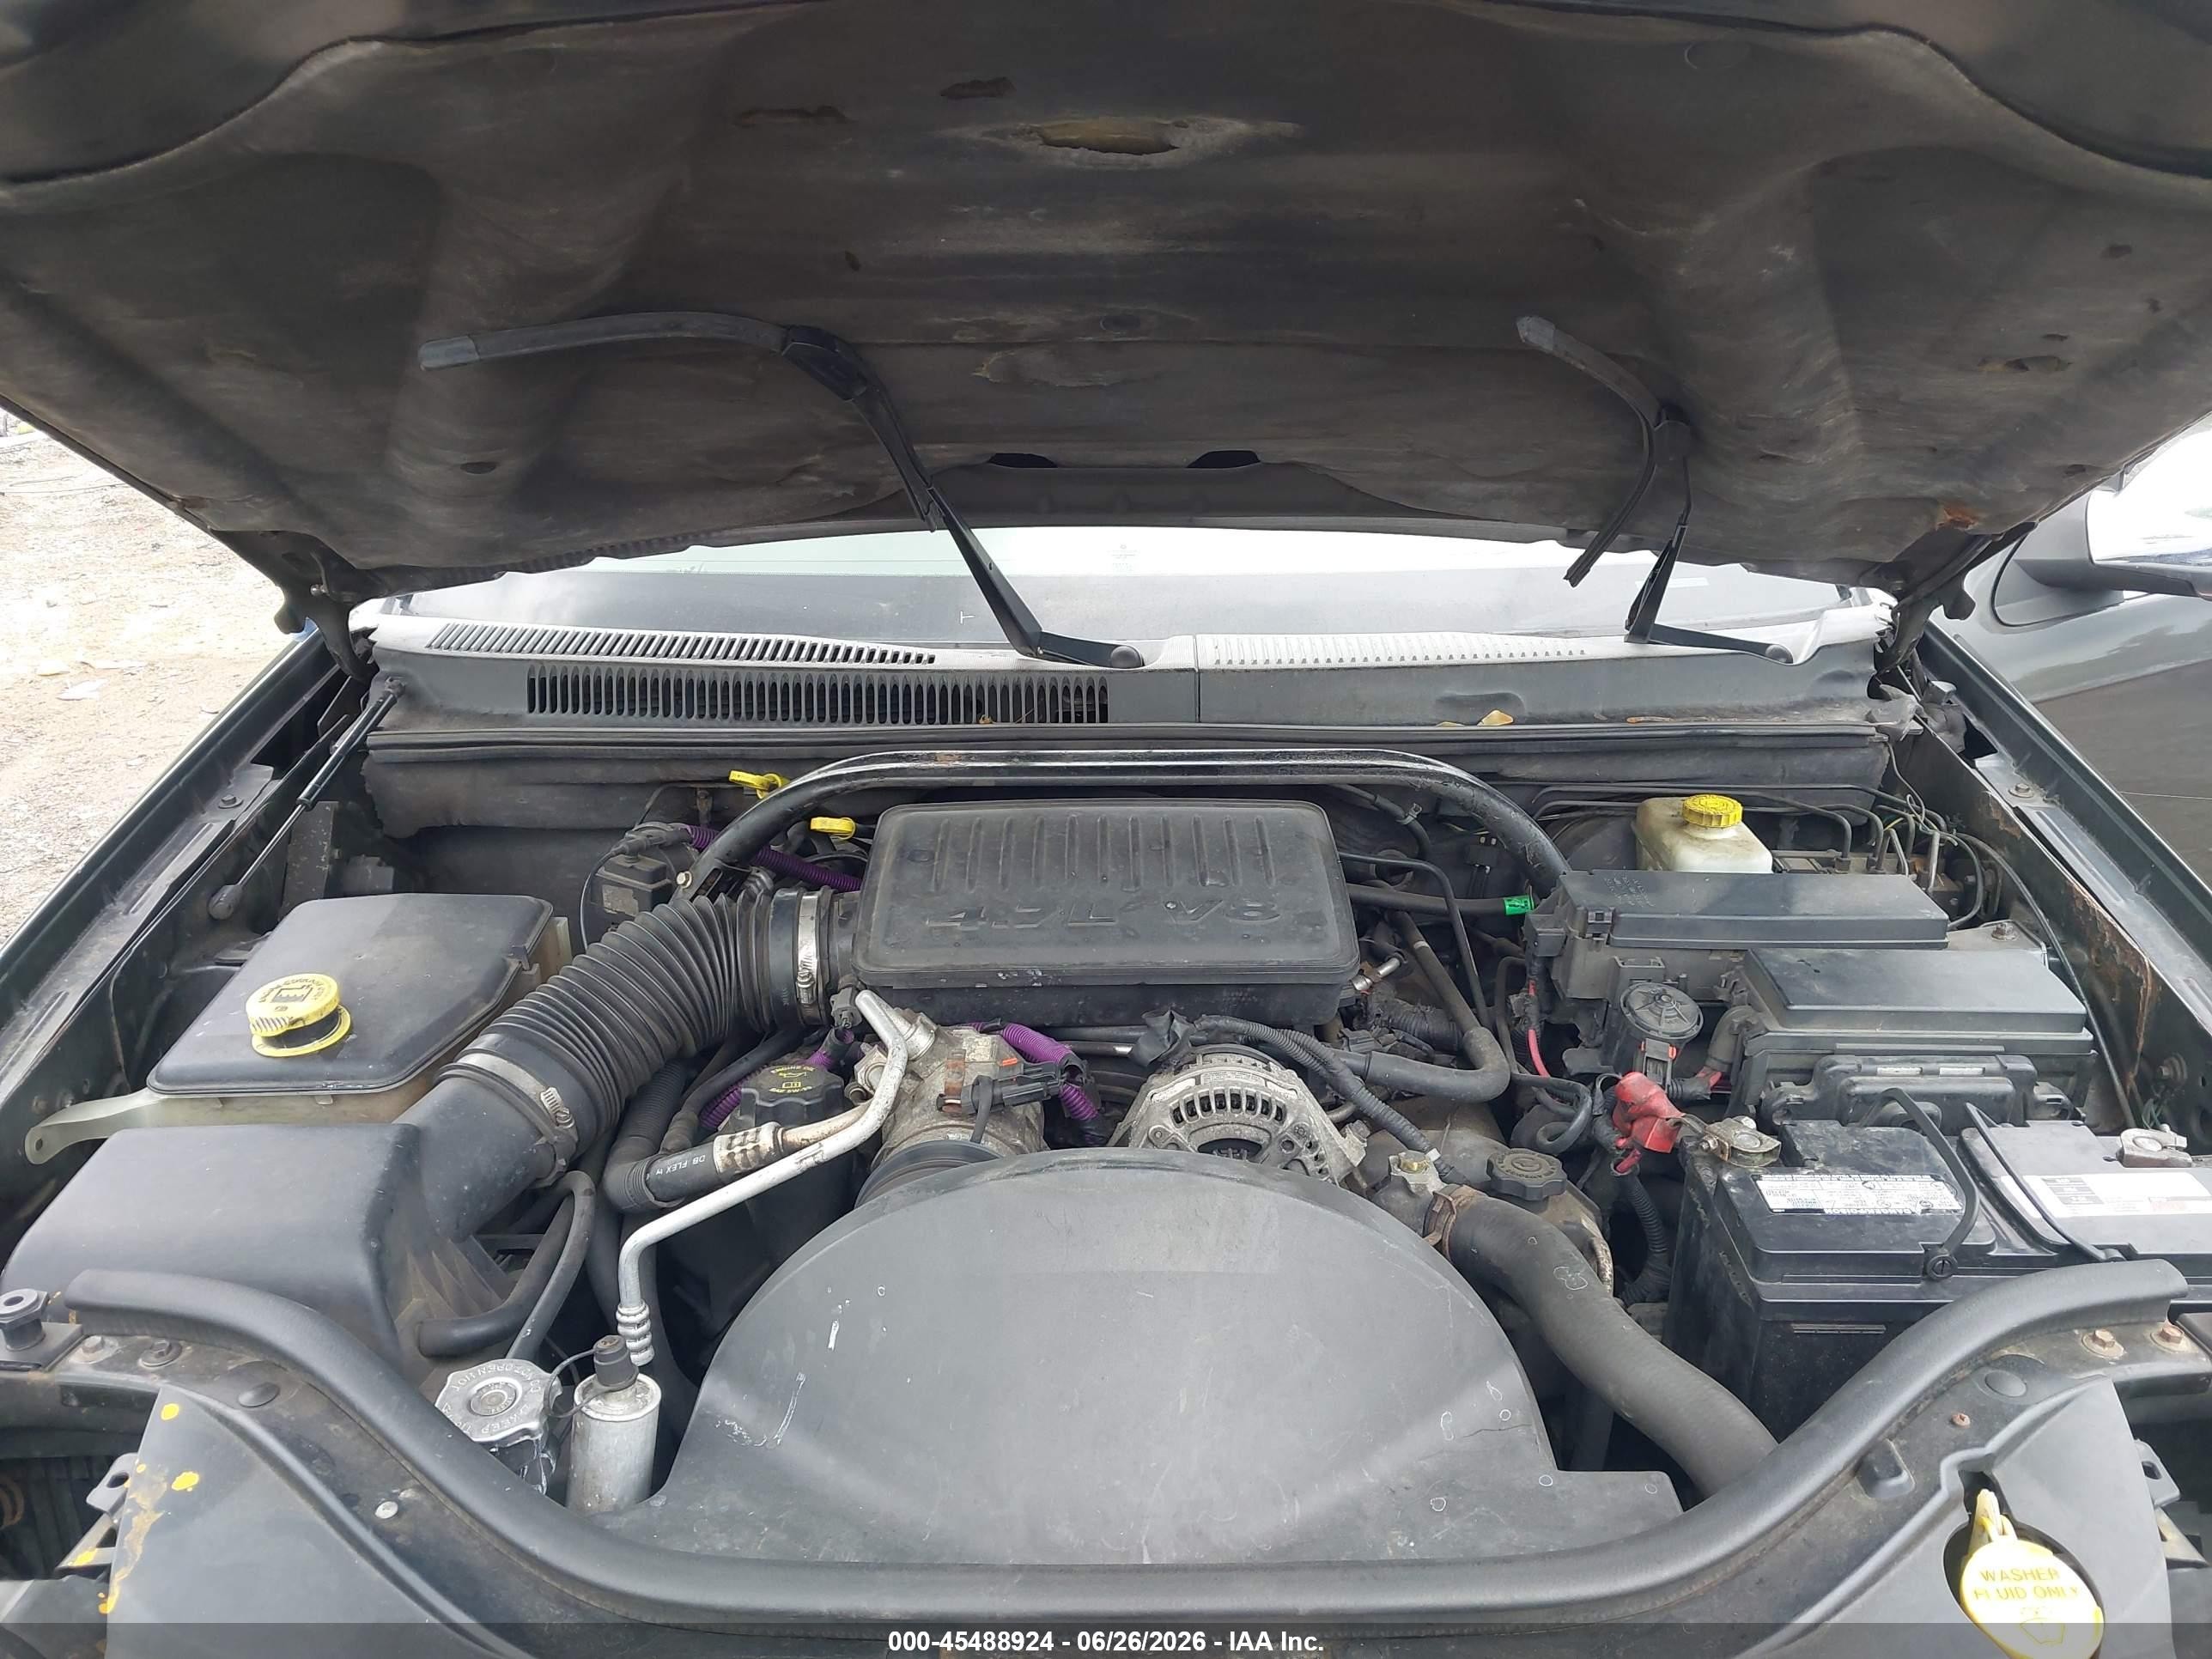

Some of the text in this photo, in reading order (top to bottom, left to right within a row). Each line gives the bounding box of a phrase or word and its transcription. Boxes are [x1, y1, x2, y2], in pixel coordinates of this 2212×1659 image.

[926, 899, 1282, 931] 4.7L V8
[692, 1155, 706, 1164] DB
[665, 1160, 688, 1175] FLEX
[477, 1364, 514, 1376] OPEN
[481, 1413, 518, 1434] KEEP
[1980, 1567, 2060, 1582] WASHER
